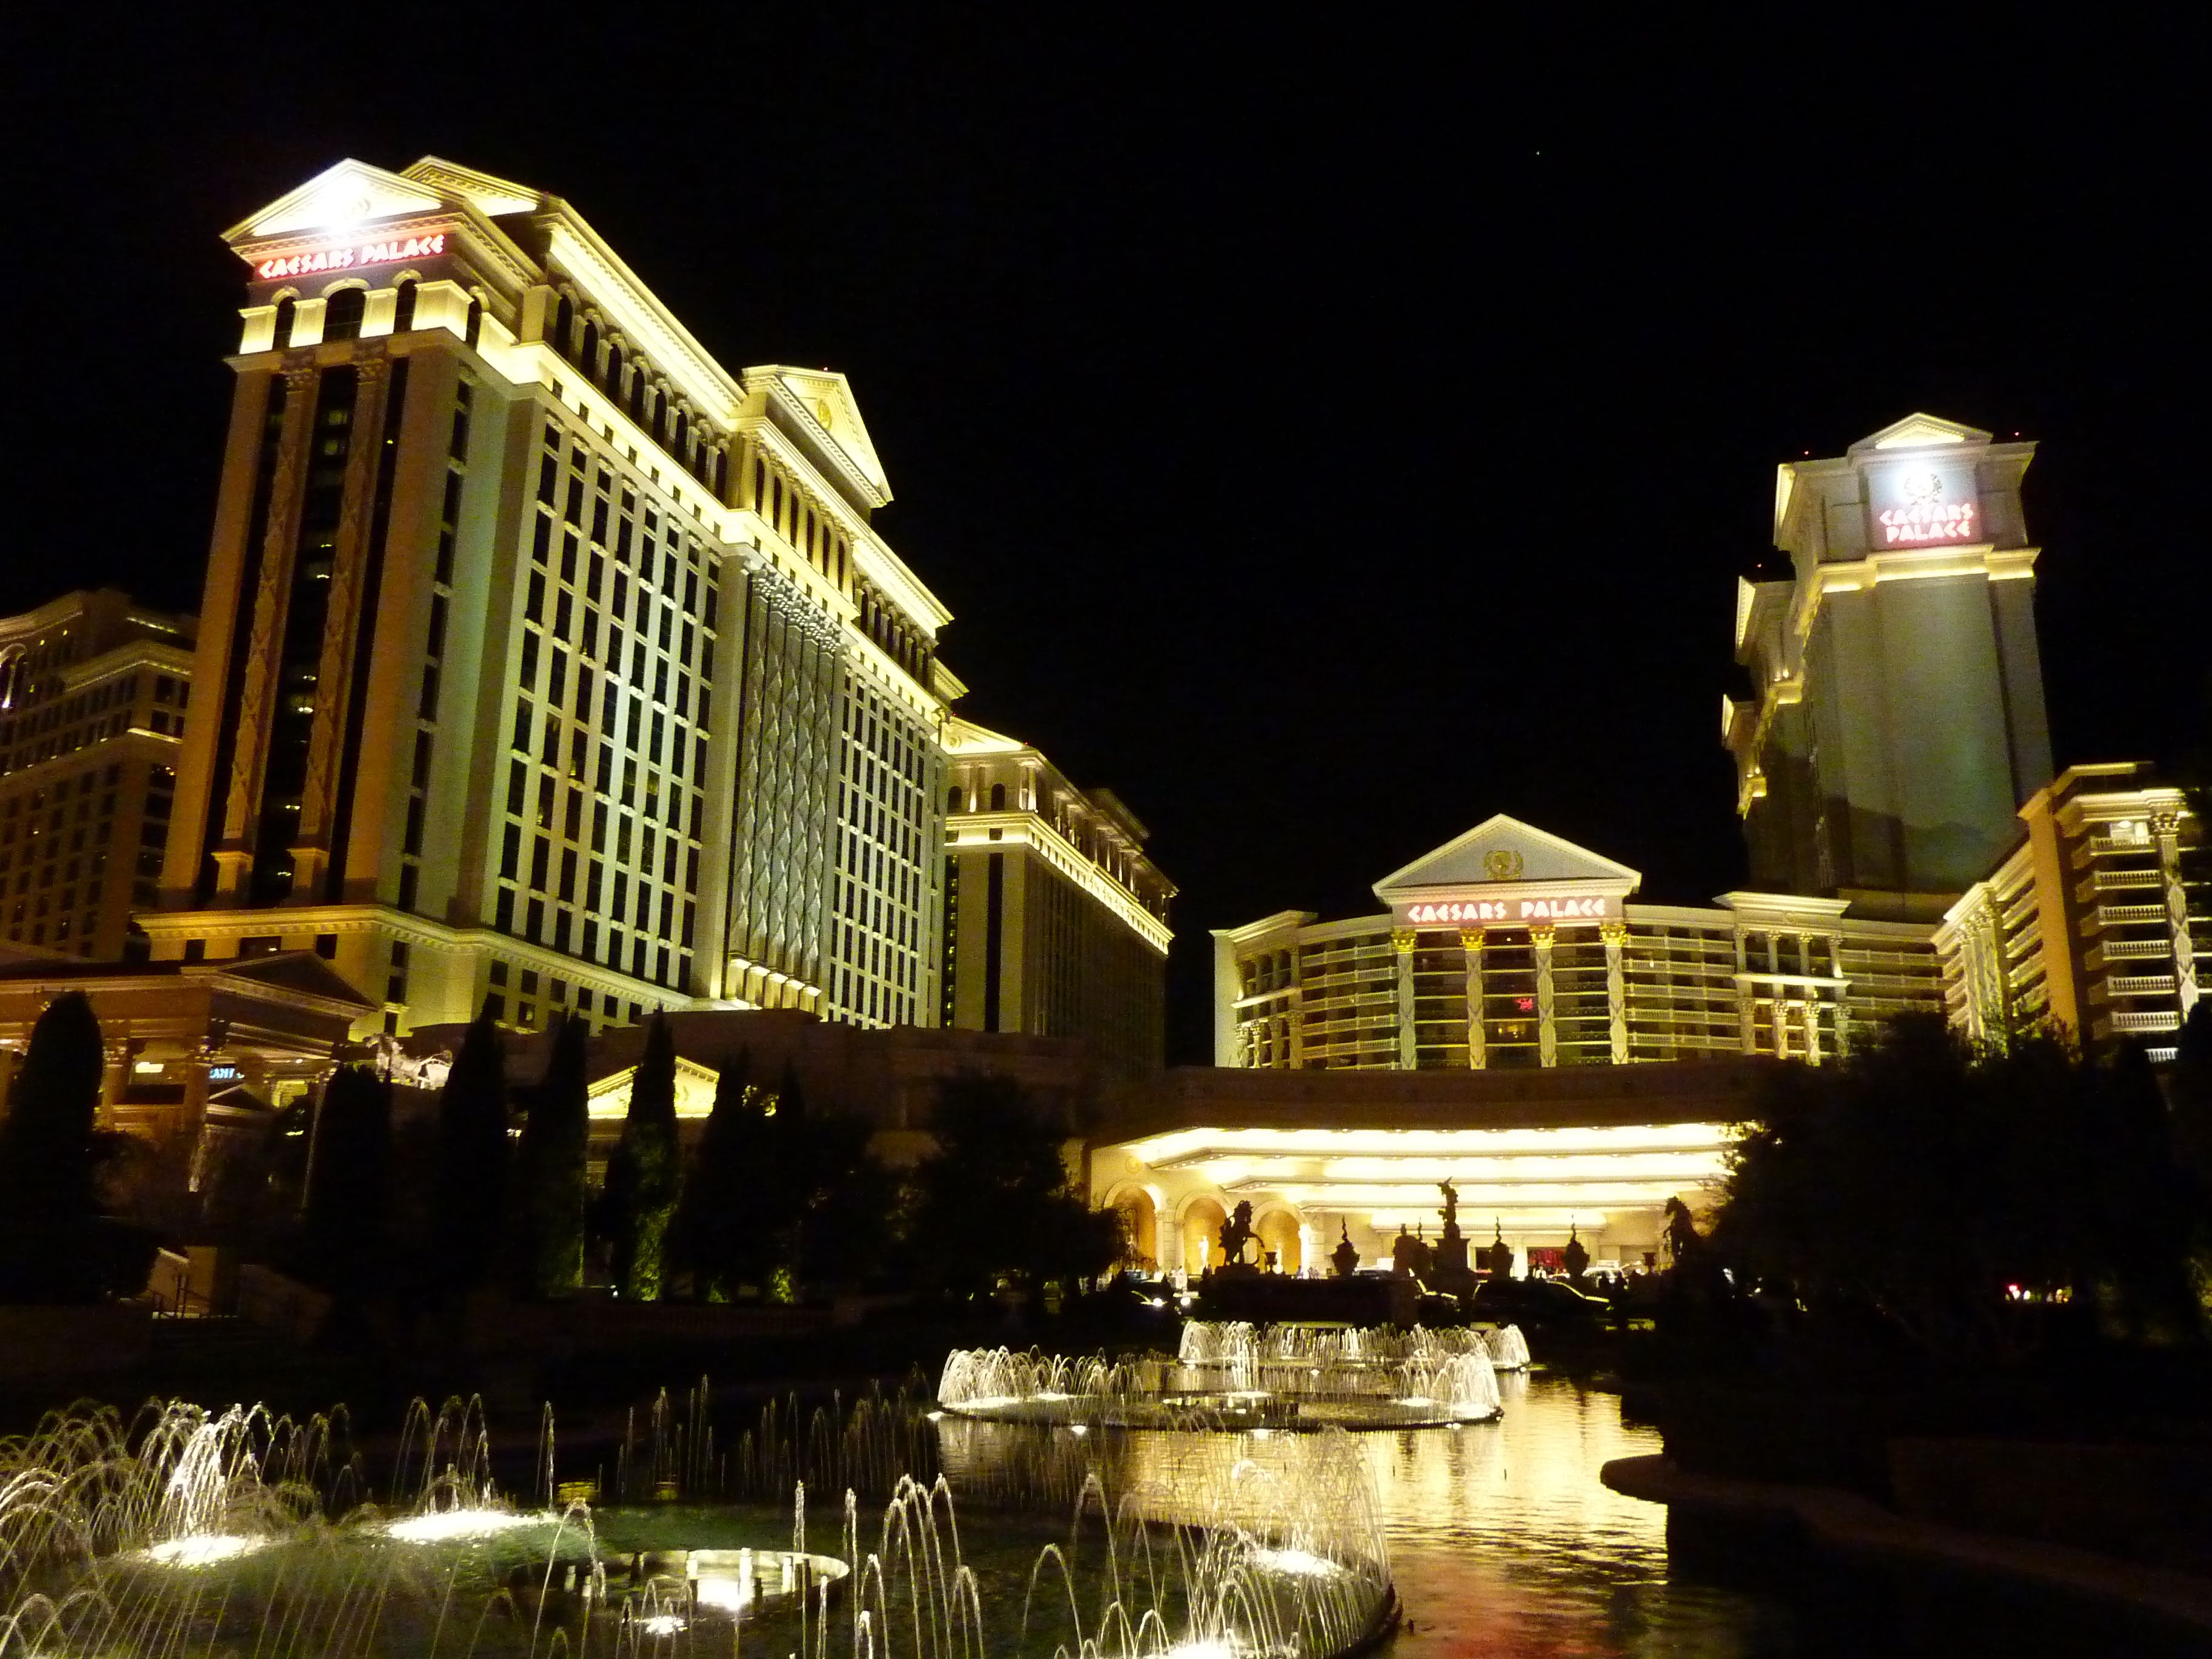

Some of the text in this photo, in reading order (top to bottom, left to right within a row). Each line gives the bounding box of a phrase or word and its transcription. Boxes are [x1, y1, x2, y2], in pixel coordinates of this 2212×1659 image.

[259, 234, 445, 279] CAESARS PALACE
[1879, 503, 1974, 526] CAESARS
[1886, 520, 1971, 543] PALACE
[1408, 899, 1605, 923] CAESARS PALACE
